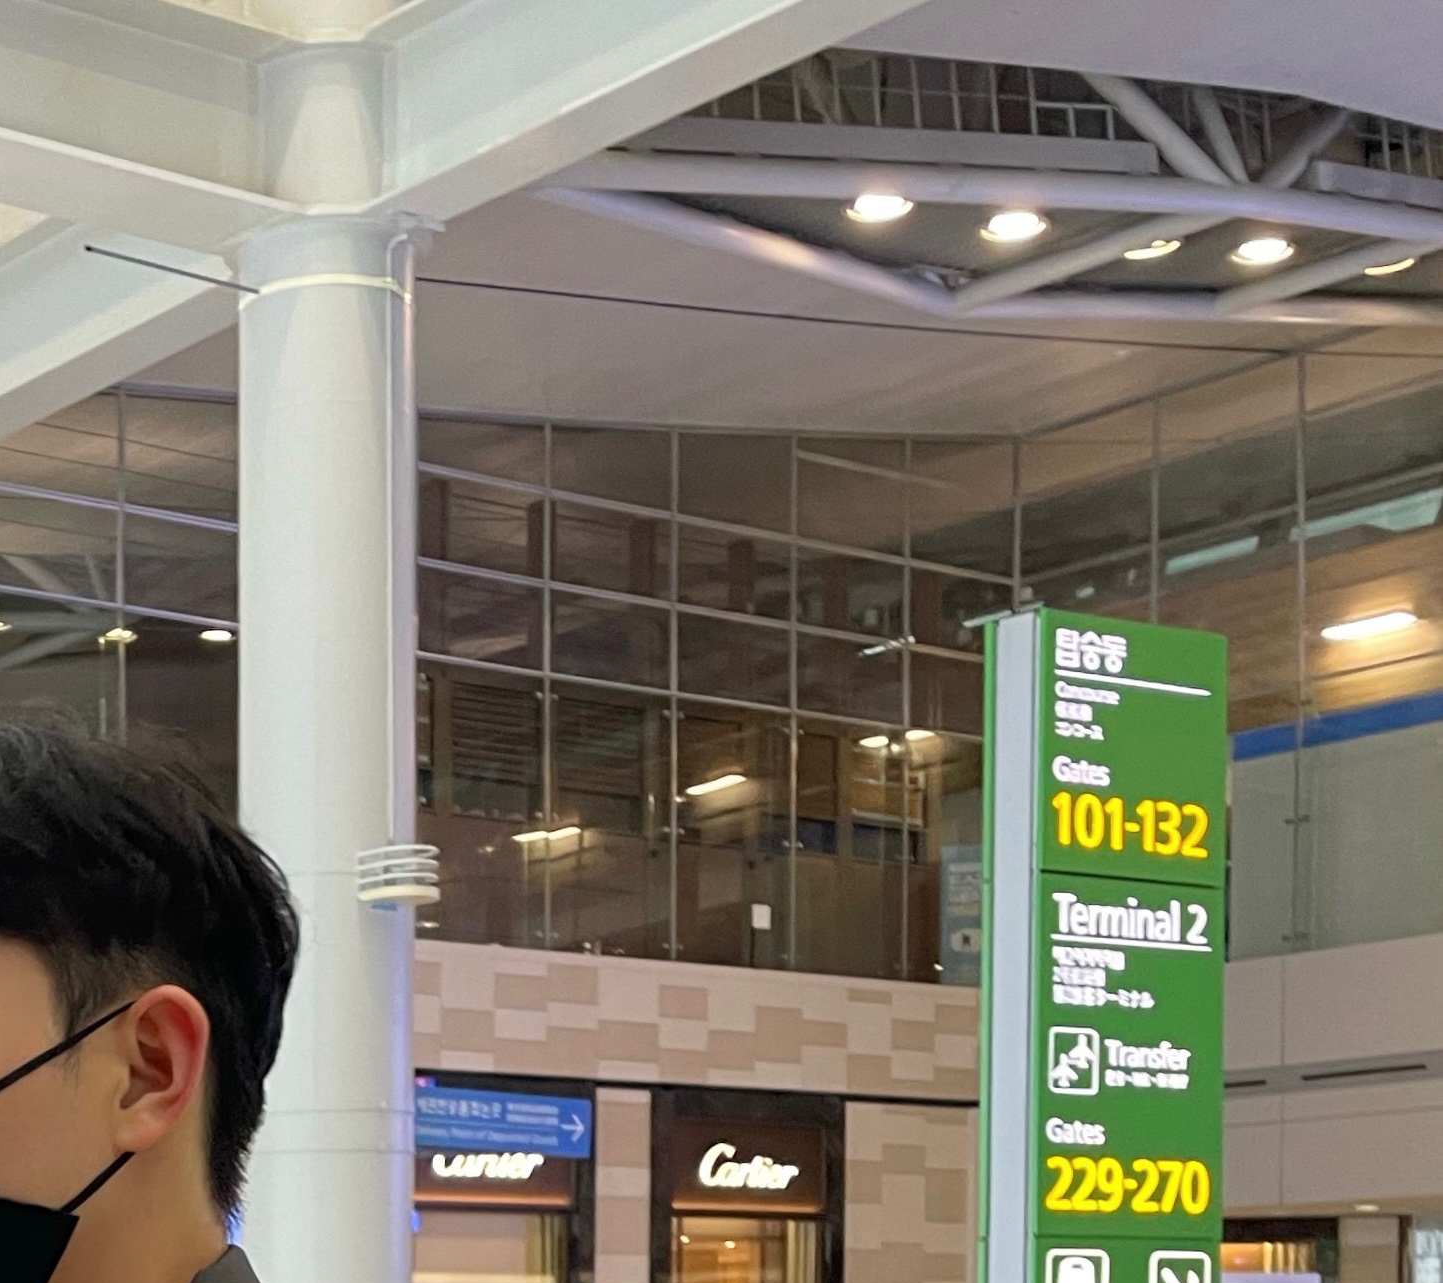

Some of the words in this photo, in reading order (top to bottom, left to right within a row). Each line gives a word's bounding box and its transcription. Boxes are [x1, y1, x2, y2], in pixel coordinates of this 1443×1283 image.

[1052, 755, 1110, 787] Gates
[1052, 791, 1209, 859] 101-132
[1052, 892, 1182, 942] Terminal
[1186, 904, 1209, 945] 2
[1104, 1038, 1192, 1071] Transfer
[1045, 1117, 1106, 1146] Gates
[699, 1142, 800, 1190] Cartier
[1045, 1156, 1210, 1215] 229-270
